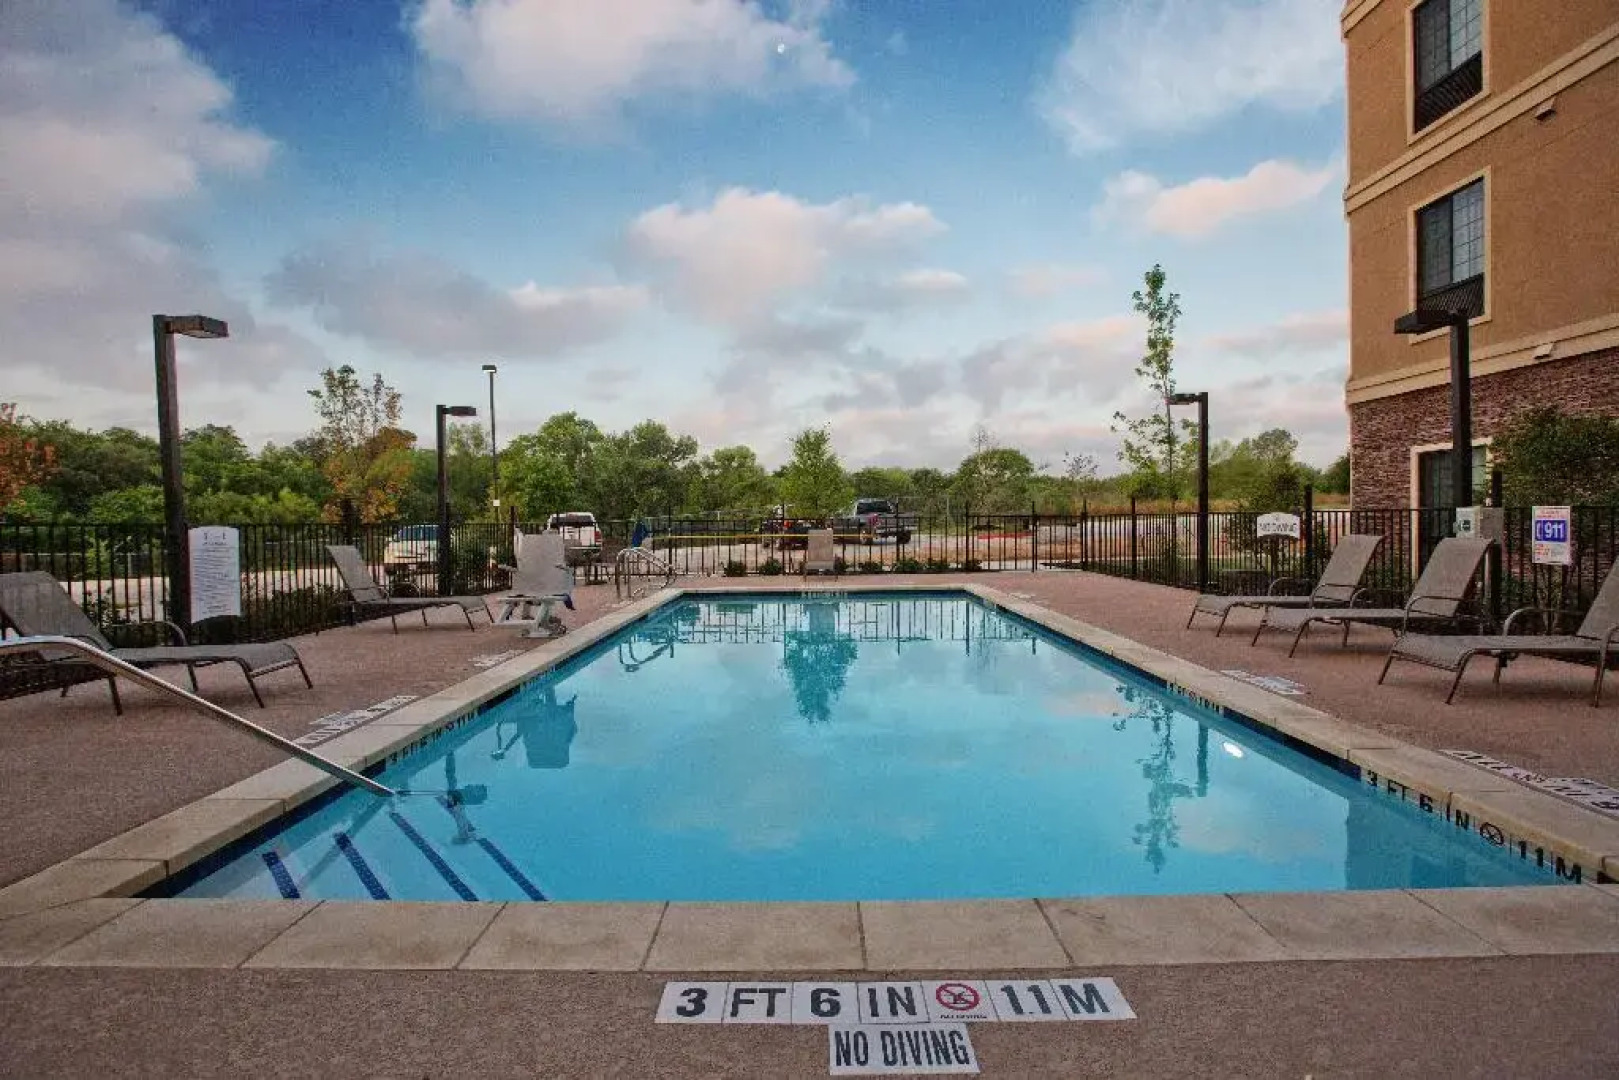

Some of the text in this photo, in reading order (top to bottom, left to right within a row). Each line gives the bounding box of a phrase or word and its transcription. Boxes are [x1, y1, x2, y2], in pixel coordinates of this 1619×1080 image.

[1544, 522, 1565, 539] 911
[1367, 769, 1378, 787] 3
[1387, 779, 1413, 800] FT
[1419, 792, 1433, 814] 6
[1445, 792, 1470, 831] IN
[1555, 856, 1582, 885] M
[676, 987, 708, 1017] 3
[730, 987, 787, 1018] FT
[810, 987, 842, 1018] 6
[867, 986, 918, 1018] IN
[1059, 983, 1111, 1014] M
[834, 1030, 970, 1067] NO DIVING
